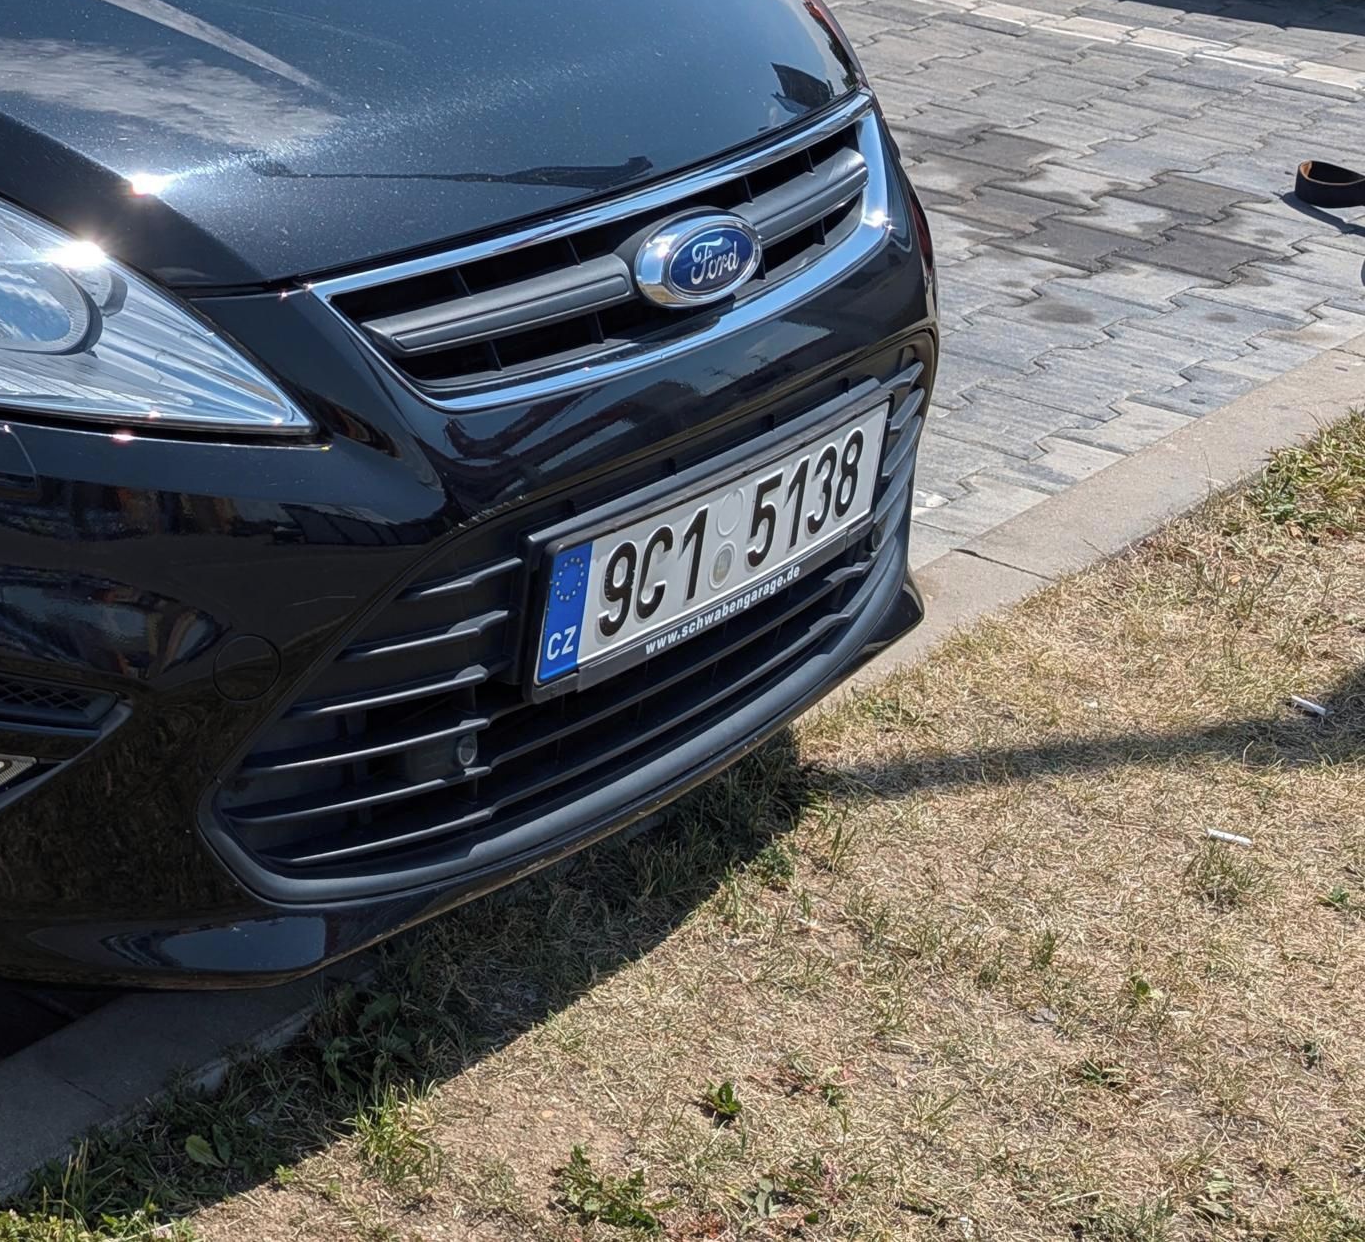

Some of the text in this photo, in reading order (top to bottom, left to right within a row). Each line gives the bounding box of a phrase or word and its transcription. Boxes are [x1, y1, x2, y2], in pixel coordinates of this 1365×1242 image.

[690, 237, 740, 285] Ford
[597, 427, 865, 637] 9C1 5138
[547, 625, 576, 661] CZ
[645, 565, 801, 655] www.schwabengarage.de
